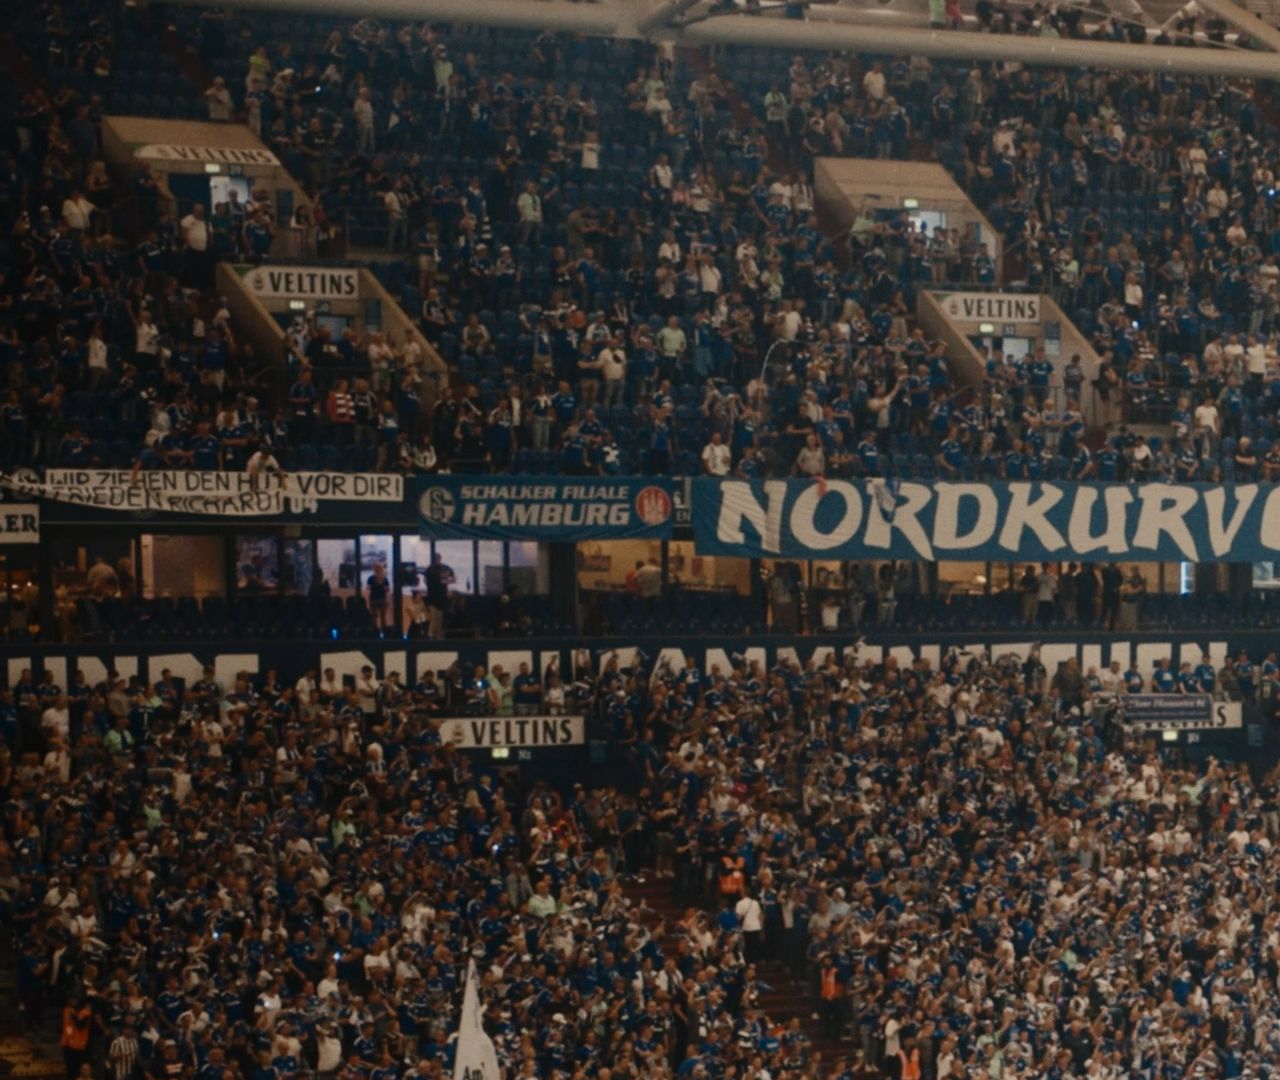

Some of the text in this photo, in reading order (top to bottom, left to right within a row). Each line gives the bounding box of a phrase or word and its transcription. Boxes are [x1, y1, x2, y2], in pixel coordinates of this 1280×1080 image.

[173, 144, 272, 165] VELTINS
[269, 272, 355, 295] VELTINS
[963, 297, 1037, 319] VELTINS
[185, 472, 232, 493] DEN
[297, 475, 346, 496] VOR
[353, 475, 401, 498] DIR!
[460, 484, 630, 499] SCHALKER FILIALE
[461, 502, 630, 526] HAMBURG
[472, 719, 573, 745] VELTINS
